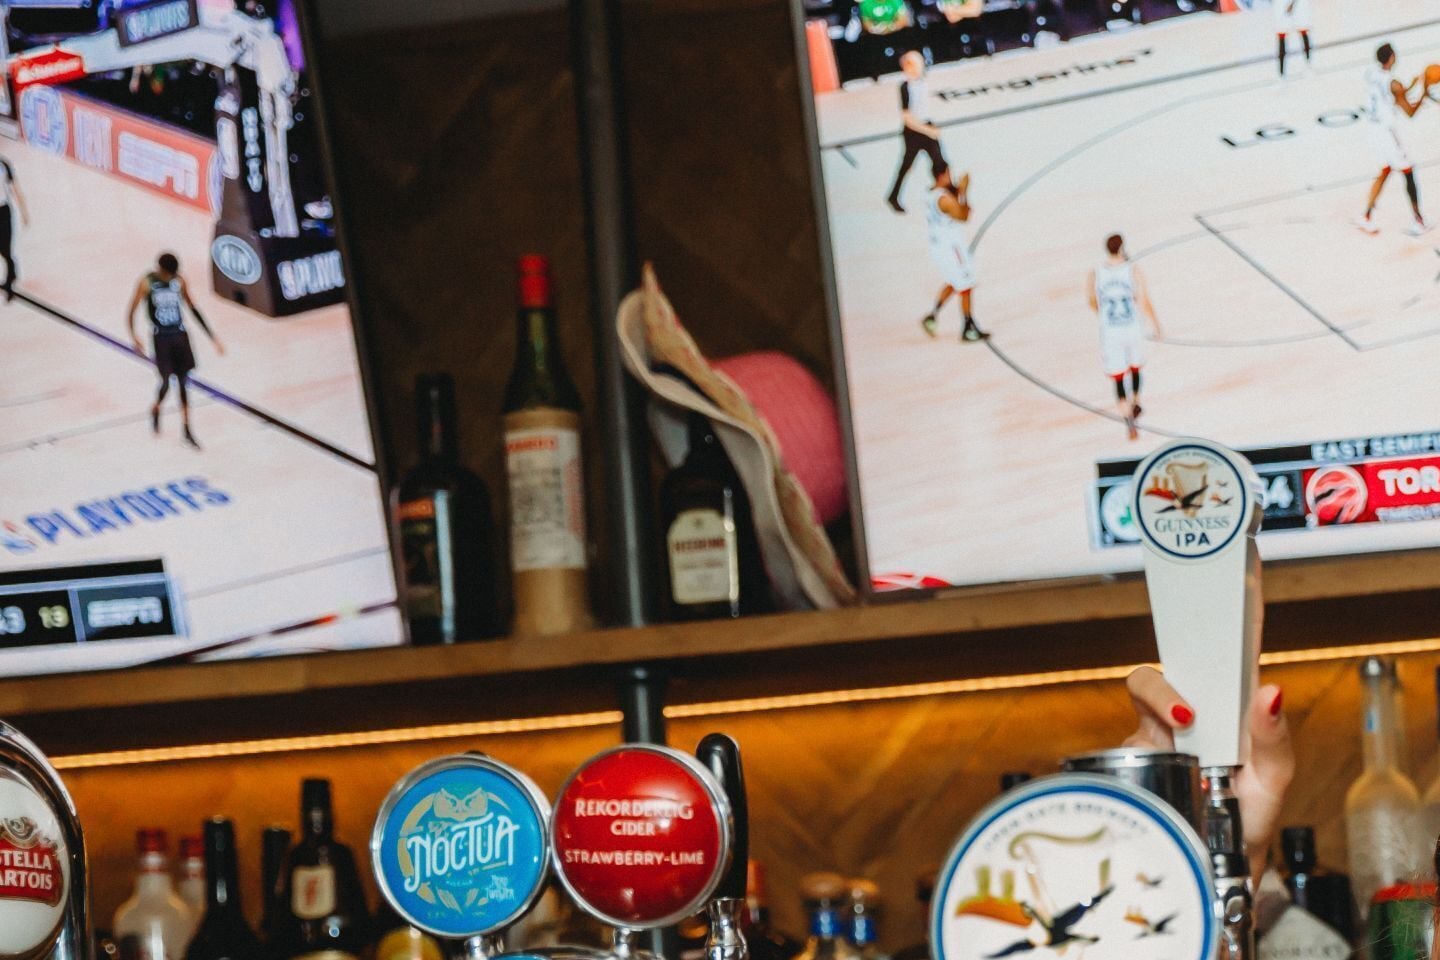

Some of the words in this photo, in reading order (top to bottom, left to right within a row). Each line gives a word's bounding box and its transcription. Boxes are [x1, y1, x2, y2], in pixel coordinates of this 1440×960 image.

[1311, 439, 1367, 462] EAST
[26, 476, 233, 545] PLAYOFFS
[1154, 516, 1230, 533] GUINNESS
[1176, 531, 1211, 547] IPA
[610, 819, 656, 837] CIDER
[564, 849, 704, 866] STRAWBERRY-LIME
